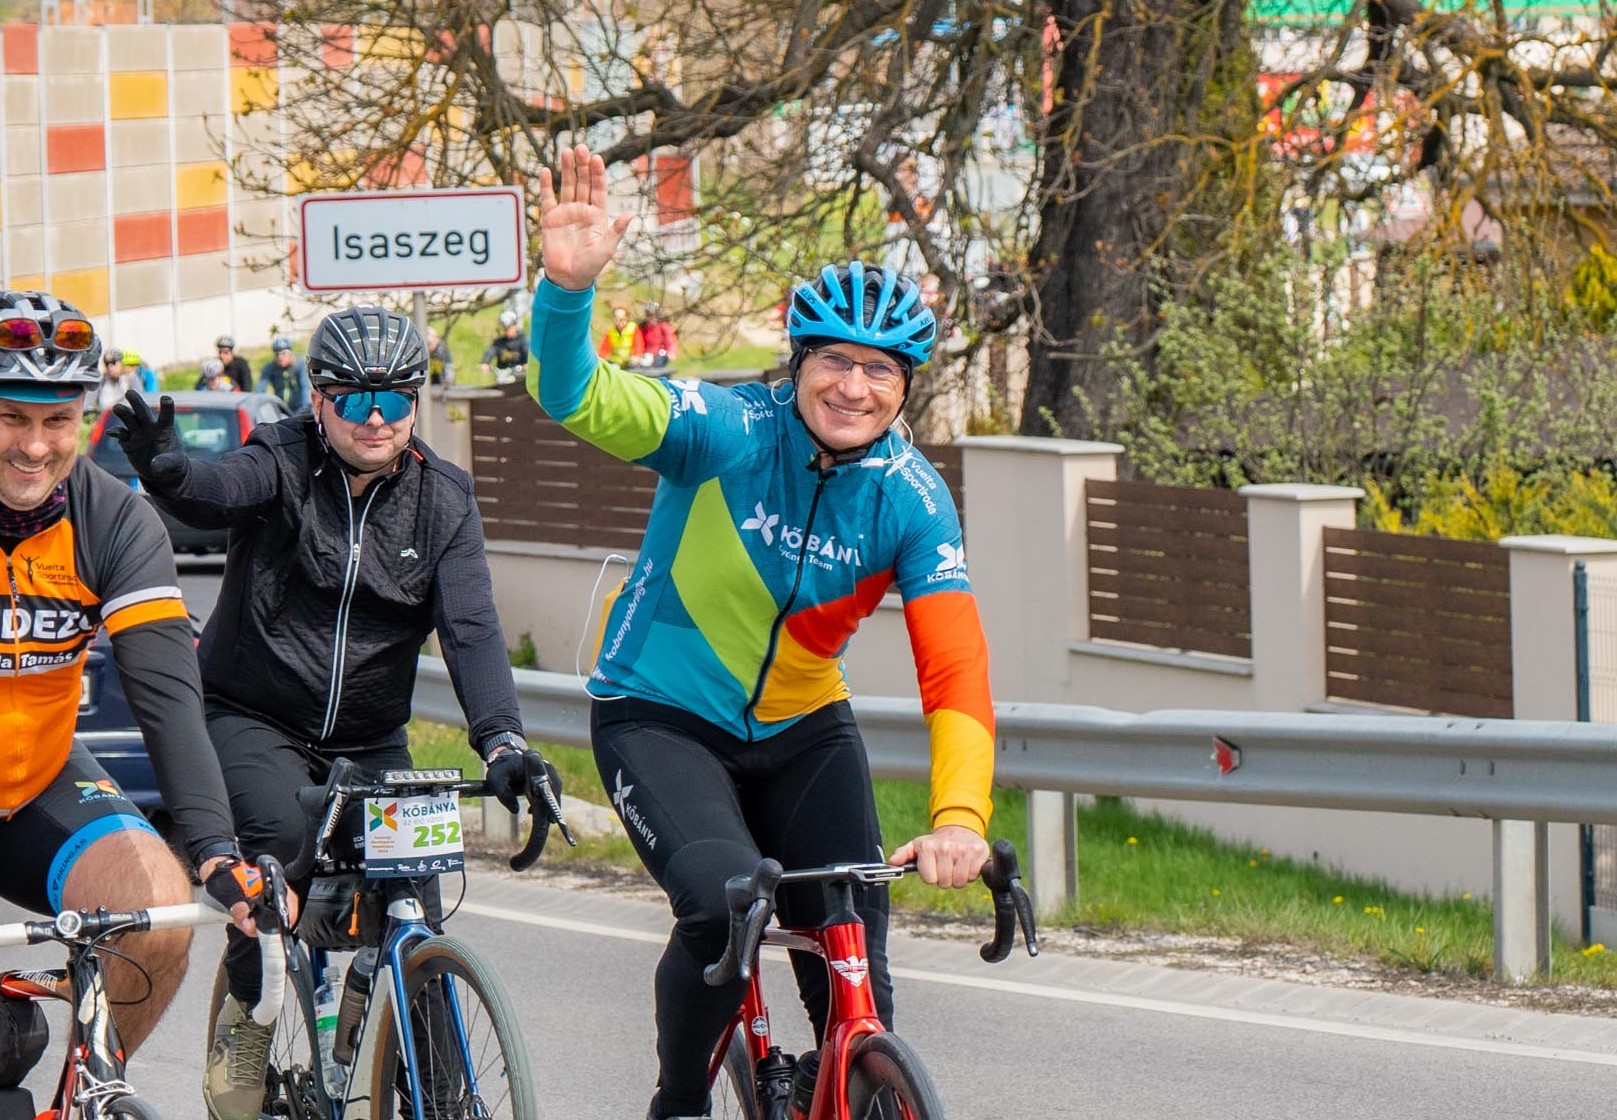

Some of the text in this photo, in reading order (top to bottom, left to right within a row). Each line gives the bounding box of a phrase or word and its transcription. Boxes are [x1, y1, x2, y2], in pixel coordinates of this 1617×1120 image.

[333, 224, 490, 266] Isaszeg
[910, 460, 937, 490] Vuelta
[900, 465, 937, 515] Sportiroda
[808, 554, 833, 571] Team
[20, 652, 73, 667] Tamás
[402, 801, 457, 818] KŐBÁNYA
[413, 820, 461, 849] 252
[625, 802, 657, 850] KŐBÁNYA
